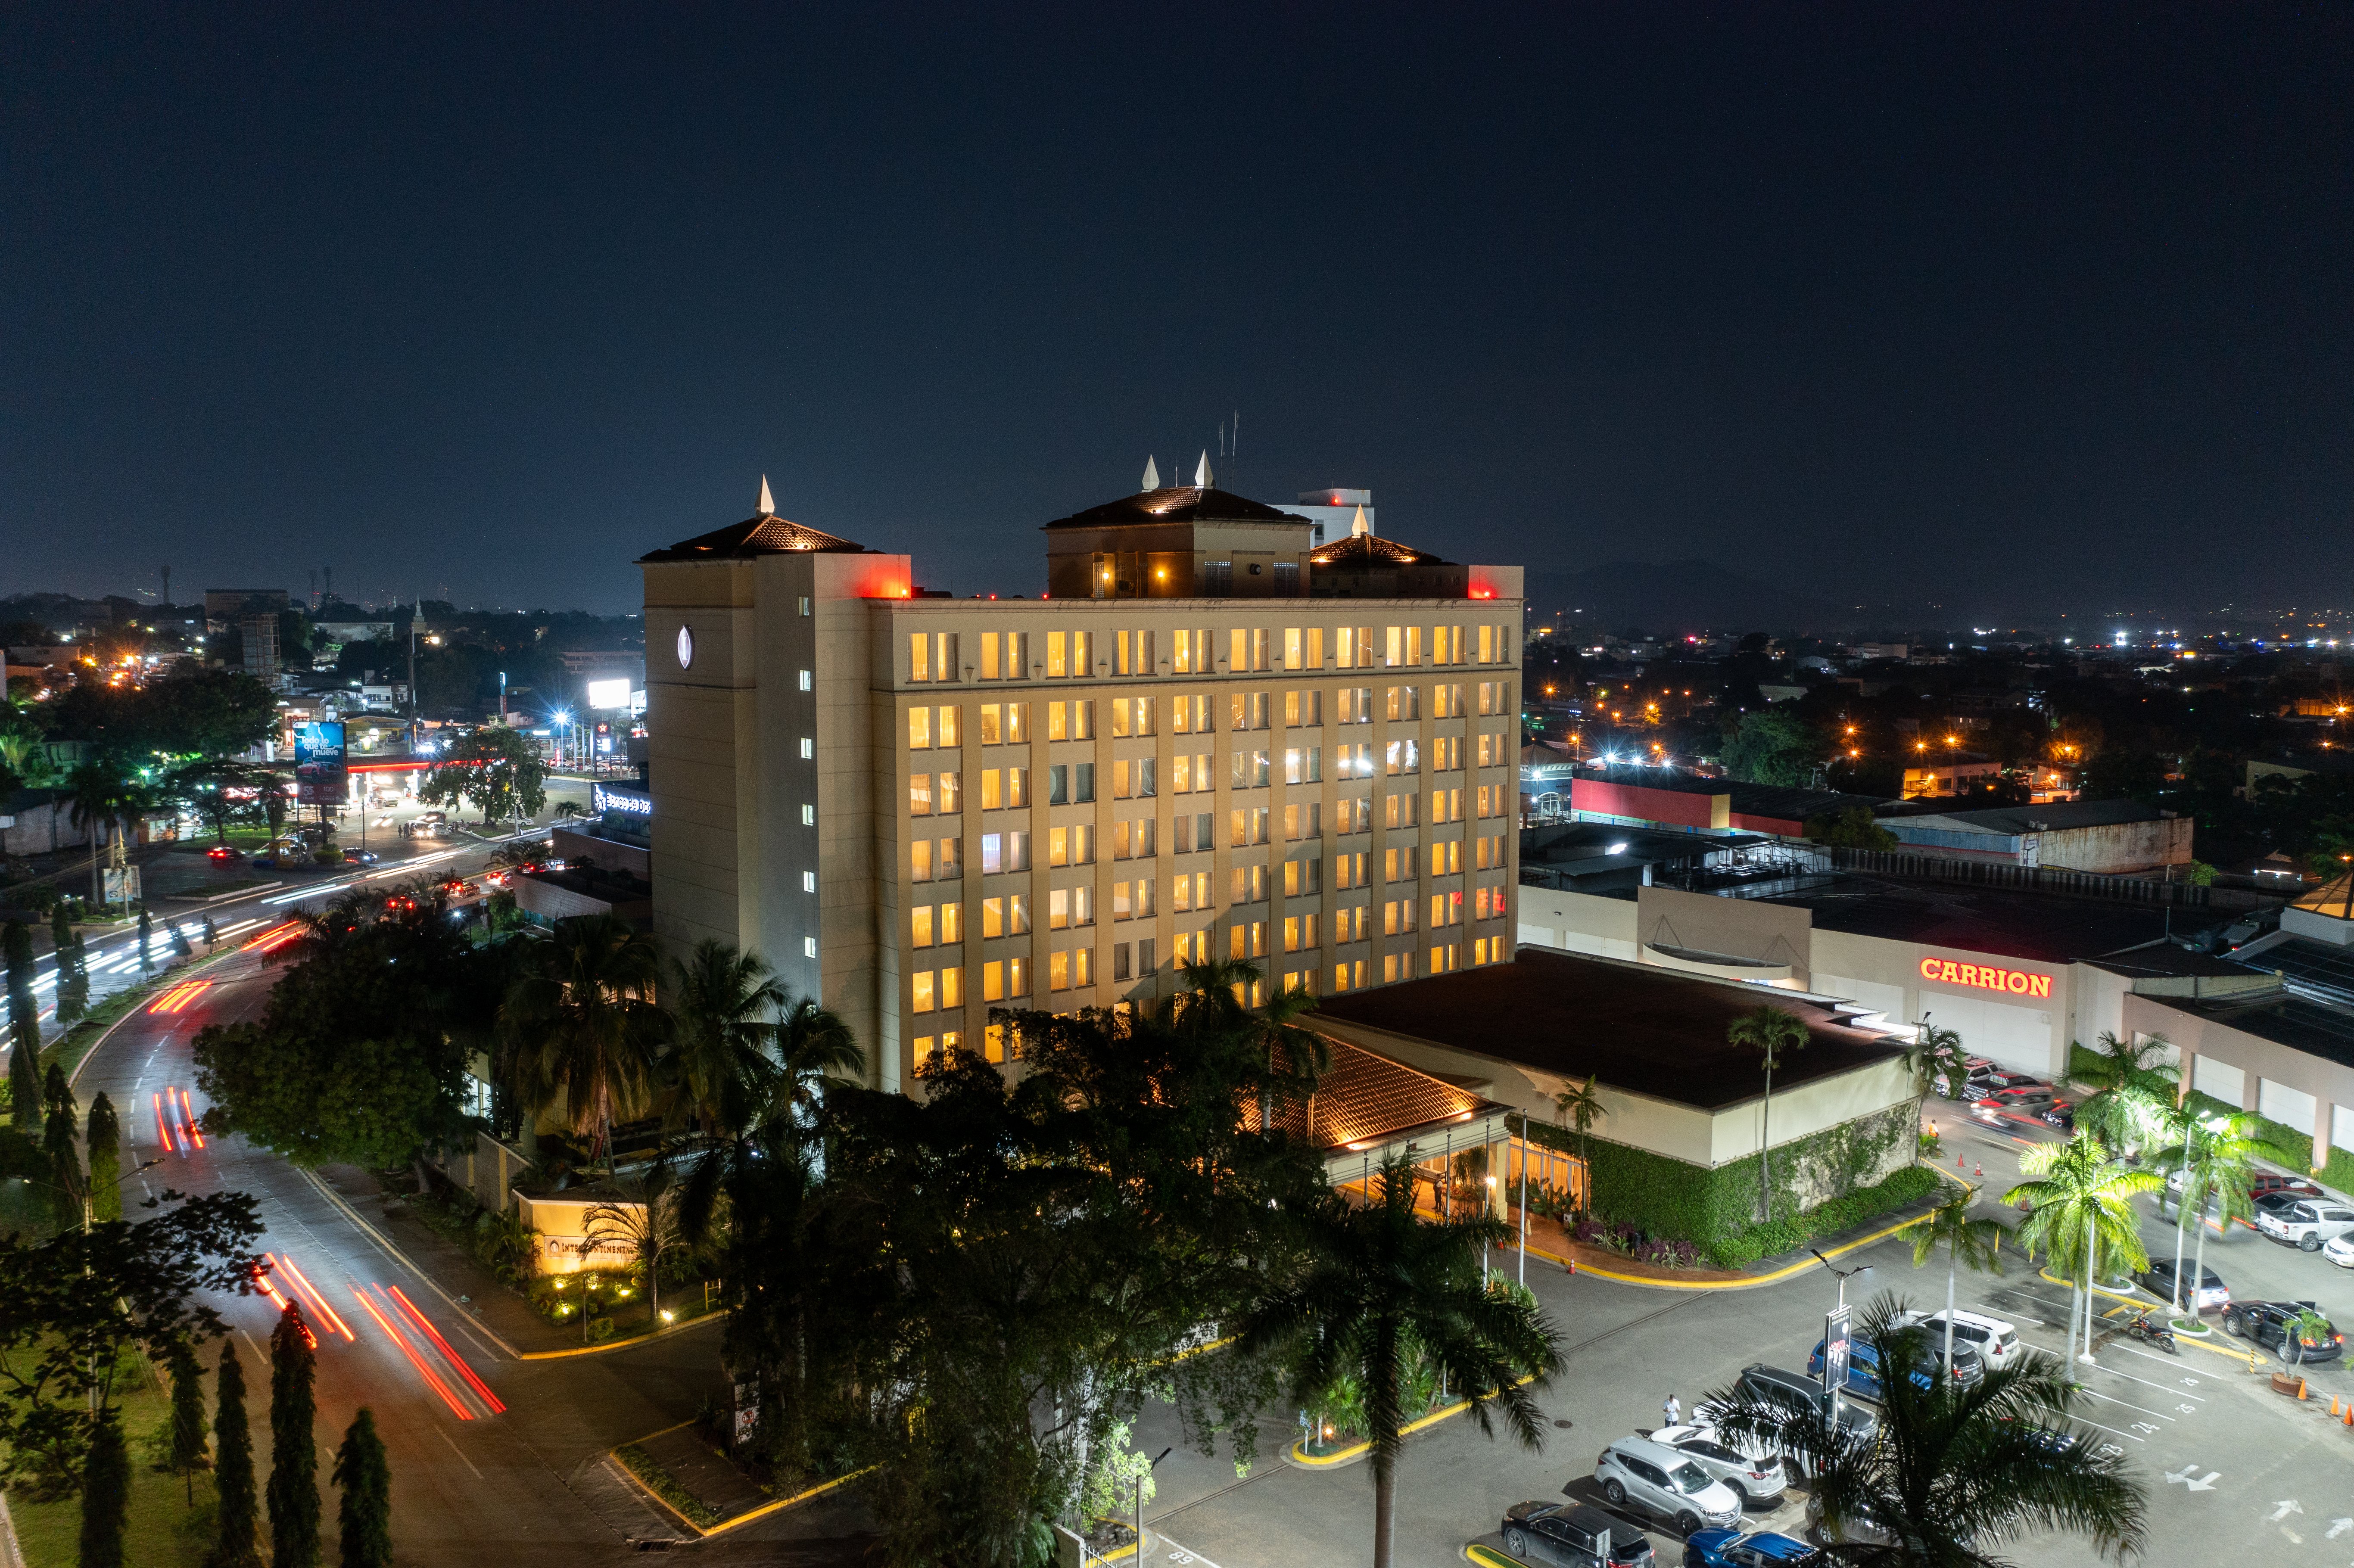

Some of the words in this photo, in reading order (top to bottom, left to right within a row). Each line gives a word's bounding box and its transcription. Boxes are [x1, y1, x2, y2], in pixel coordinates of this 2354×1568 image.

[301, 736, 319, 744] Todo
[1920, 958, 2052, 998] CARRION
[2175, 1403, 2195, 1413] 25
[2130, 1421, 2160, 1434] 24
[2099, 1444, 2124, 1456] 23
